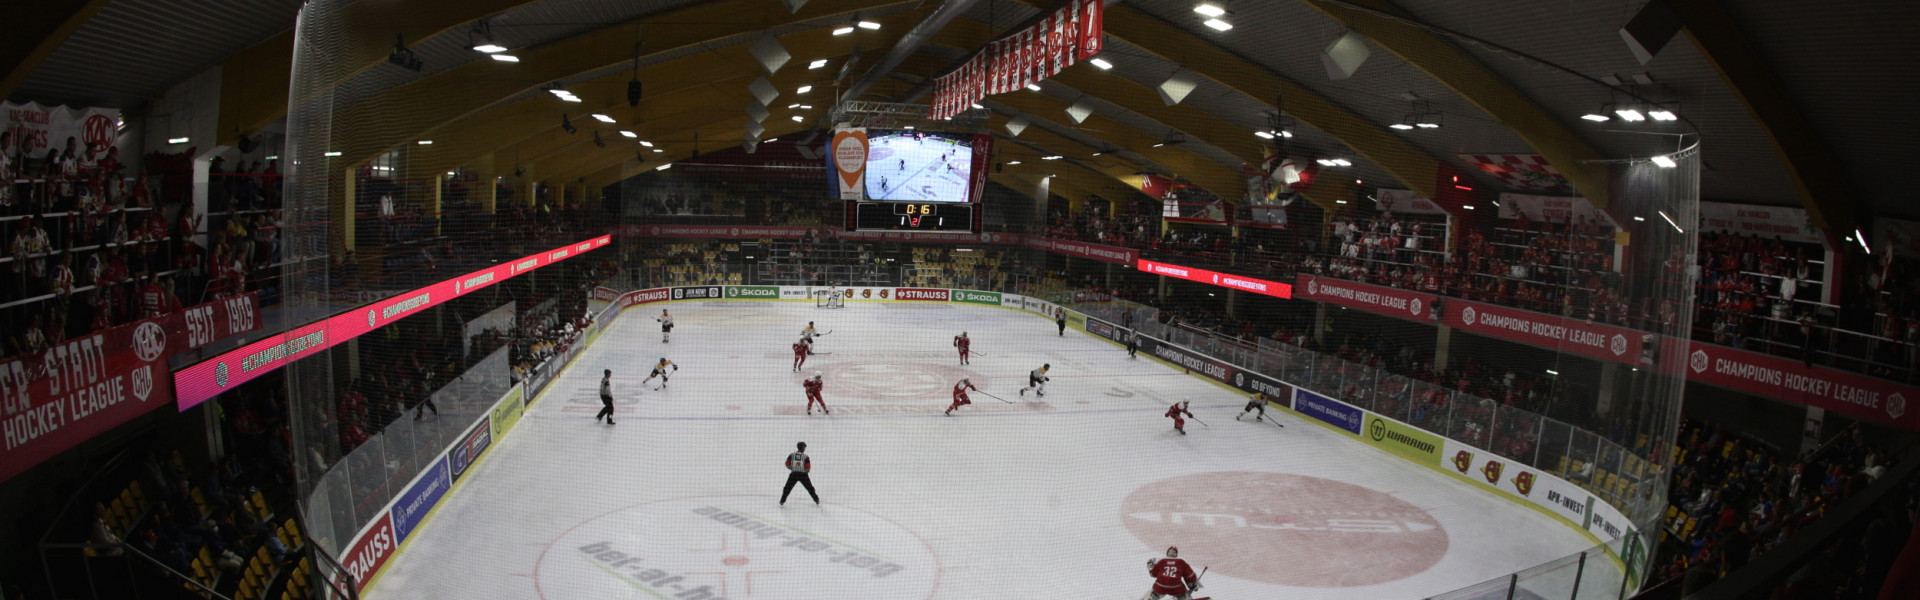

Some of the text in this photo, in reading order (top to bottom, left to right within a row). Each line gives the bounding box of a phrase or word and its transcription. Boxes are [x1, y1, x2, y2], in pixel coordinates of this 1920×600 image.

[86, 116, 112, 150] KAC
[911, 217, 919, 226] 2
[636, 291, 667, 302] STRAUSS
[741, 287, 776, 296] ŠKODA
[905, 290, 947, 300] STRAUSS
[967, 293, 999, 303] ŠKODA
[1320, 284, 1407, 310] CHAMPIONS HOCKEY LEAGUE
[185, 305, 214, 348] SEIT
[225, 296, 254, 336] 1909
[1480, 312, 1530, 333] CHAMPIONS
[1531, 322, 1567, 341] HOCKEY
[1569, 329, 1606, 349] LEAGUE
[242, 328, 324, 373] #CHAMPIONSGOBEYOND
[1156, 345, 1226, 381] CHAMPIONS HOCKEY LEAGUE
[0, 335, 107, 418] ER STADT
[1251, 379, 1259, 389] GO
[1690, 349, 1907, 420] CHL CHAMPIONS HOCKEY LEAGUE CHL
[3, 375, 126, 450] HOCKEY LEAGUE
[1308, 401, 1326, 414] PRIVATE
[1326, 406, 1348, 422] BANKING
[1387, 430, 1435, 454] WARRIOR
[406, 477, 441, 518] PRIVATE BANKING
[1162, 566, 1178, 578] 32
